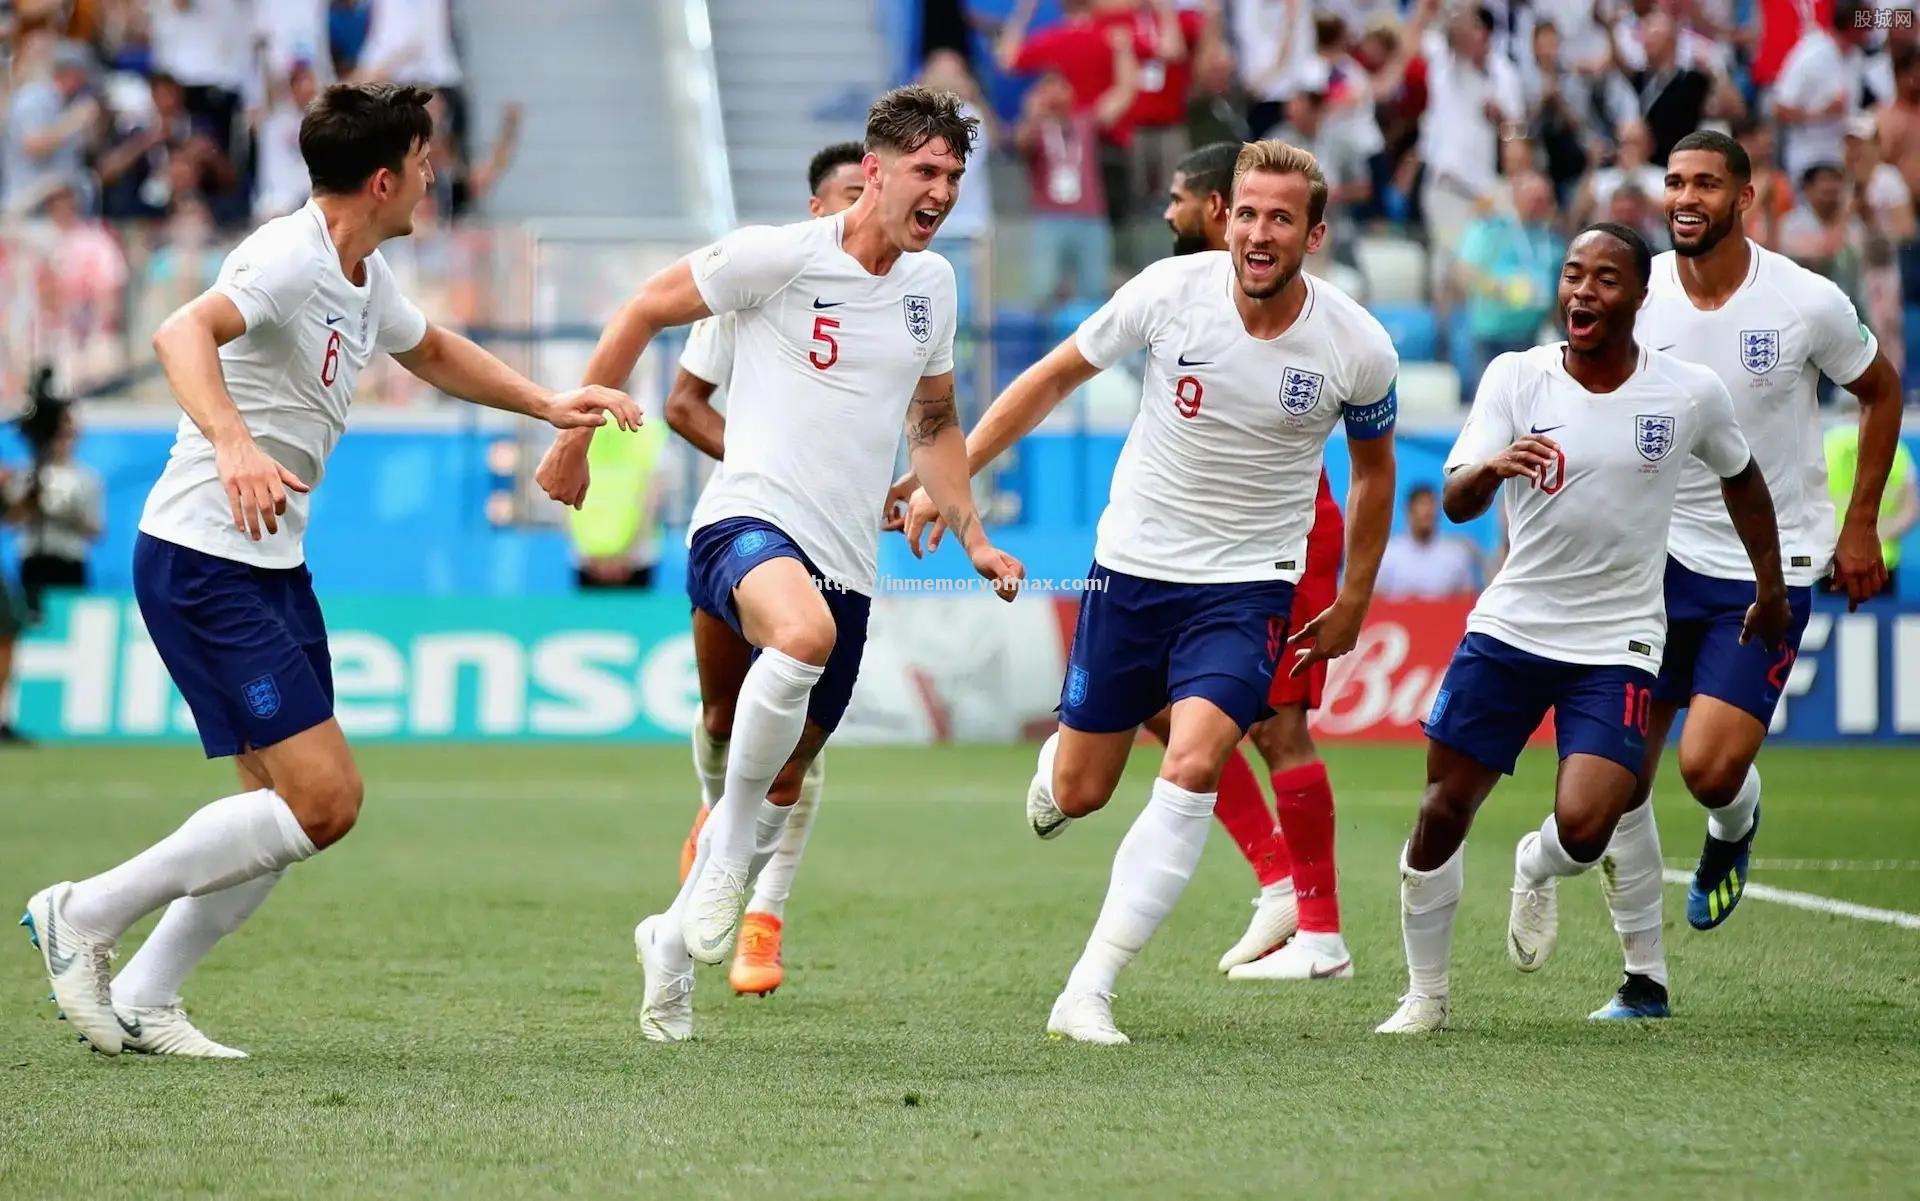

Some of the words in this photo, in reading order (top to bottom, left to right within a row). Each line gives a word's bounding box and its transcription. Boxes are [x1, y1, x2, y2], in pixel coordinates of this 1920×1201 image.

[321, 330, 340, 387] 6
[809, 317, 840, 370] 5
[1175, 376, 1203, 418] 9
[8, 597, 701, 735] Hiense
[1623, 682, 1651, 737] 10
